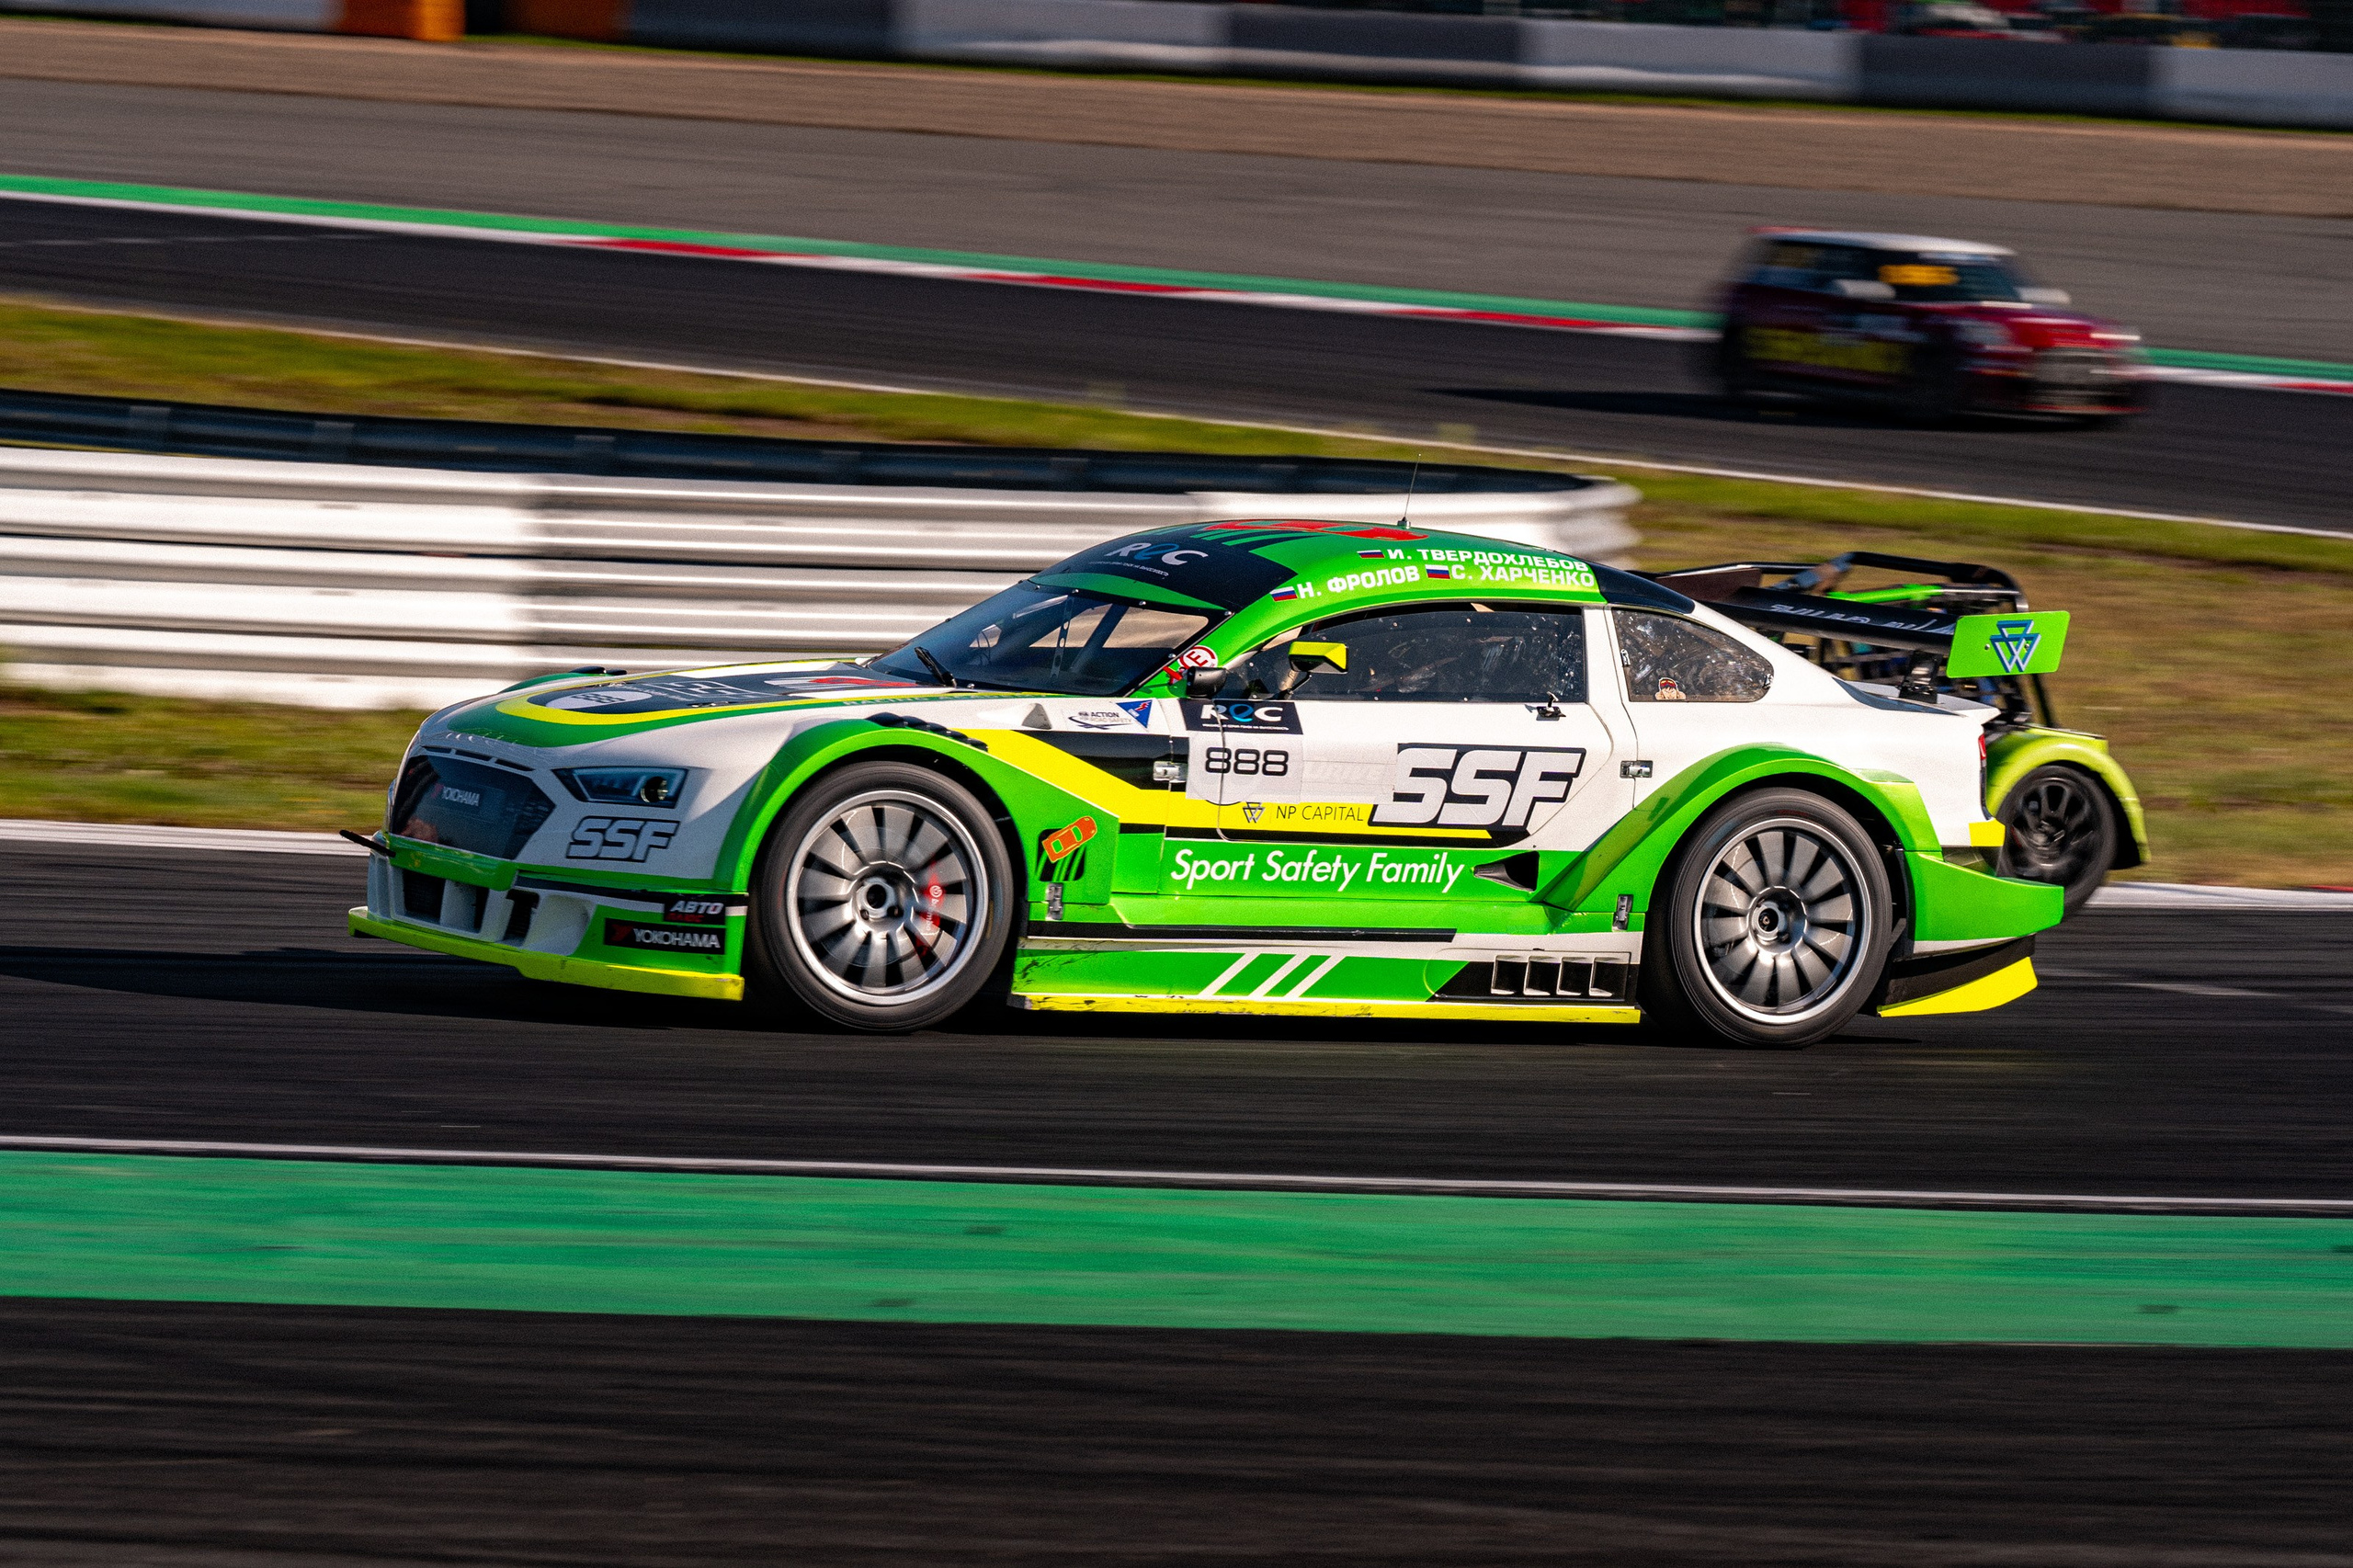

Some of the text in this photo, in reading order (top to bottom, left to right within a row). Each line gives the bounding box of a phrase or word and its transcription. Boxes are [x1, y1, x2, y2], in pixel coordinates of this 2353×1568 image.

[1387, 549, 1589, 572] И. ТВЕРДОХЛЕБОВ
[1296, 565, 1420, 599] Н. ФРОЛОВ
[1451, 564, 1595, 587] С. ХАРЧЕНКО
[1186, 651, 1209, 667] E
[1205, 746, 1290, 777] 888
[441, 786, 481, 807] YOKOHAMA
[1369, 744, 1586, 827] SSF
[1276, 805, 1364, 822] NP CAPITAL
[566, 815, 680, 863] SSF
[1170, 849, 1465, 893] Sport Safety Family
[669, 900, 724, 915] АВТО
[632, 927, 722, 949] YOKOHAMA
